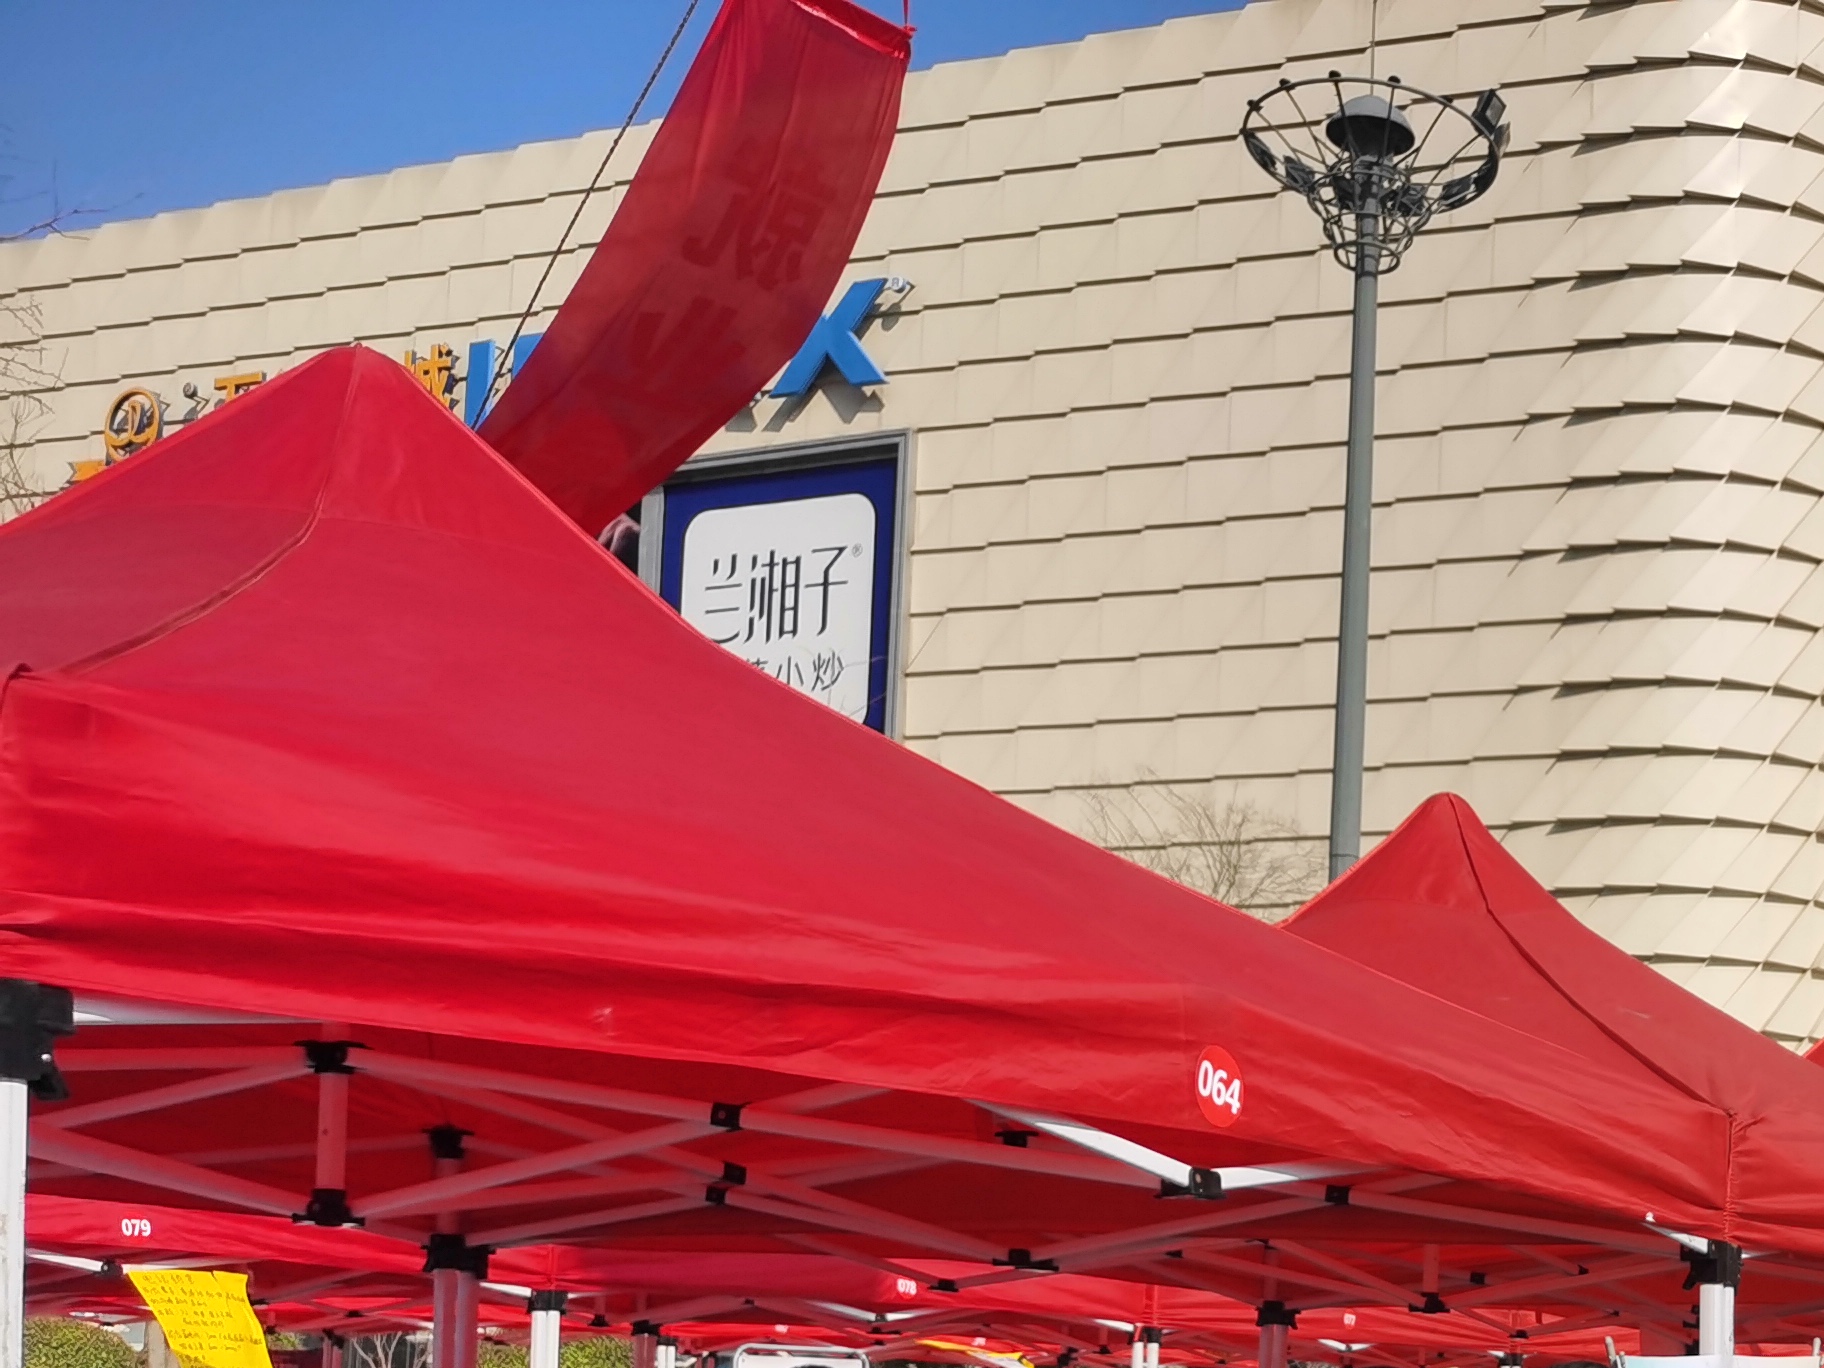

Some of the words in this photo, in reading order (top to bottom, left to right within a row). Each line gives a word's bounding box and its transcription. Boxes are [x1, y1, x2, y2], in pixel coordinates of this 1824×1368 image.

[704, 545, 848, 645] 兰湘子
[1198, 1060, 1241, 1115] 064
[121, 1218, 152, 1237] 079
[896, 1278, 917, 1296] 078
